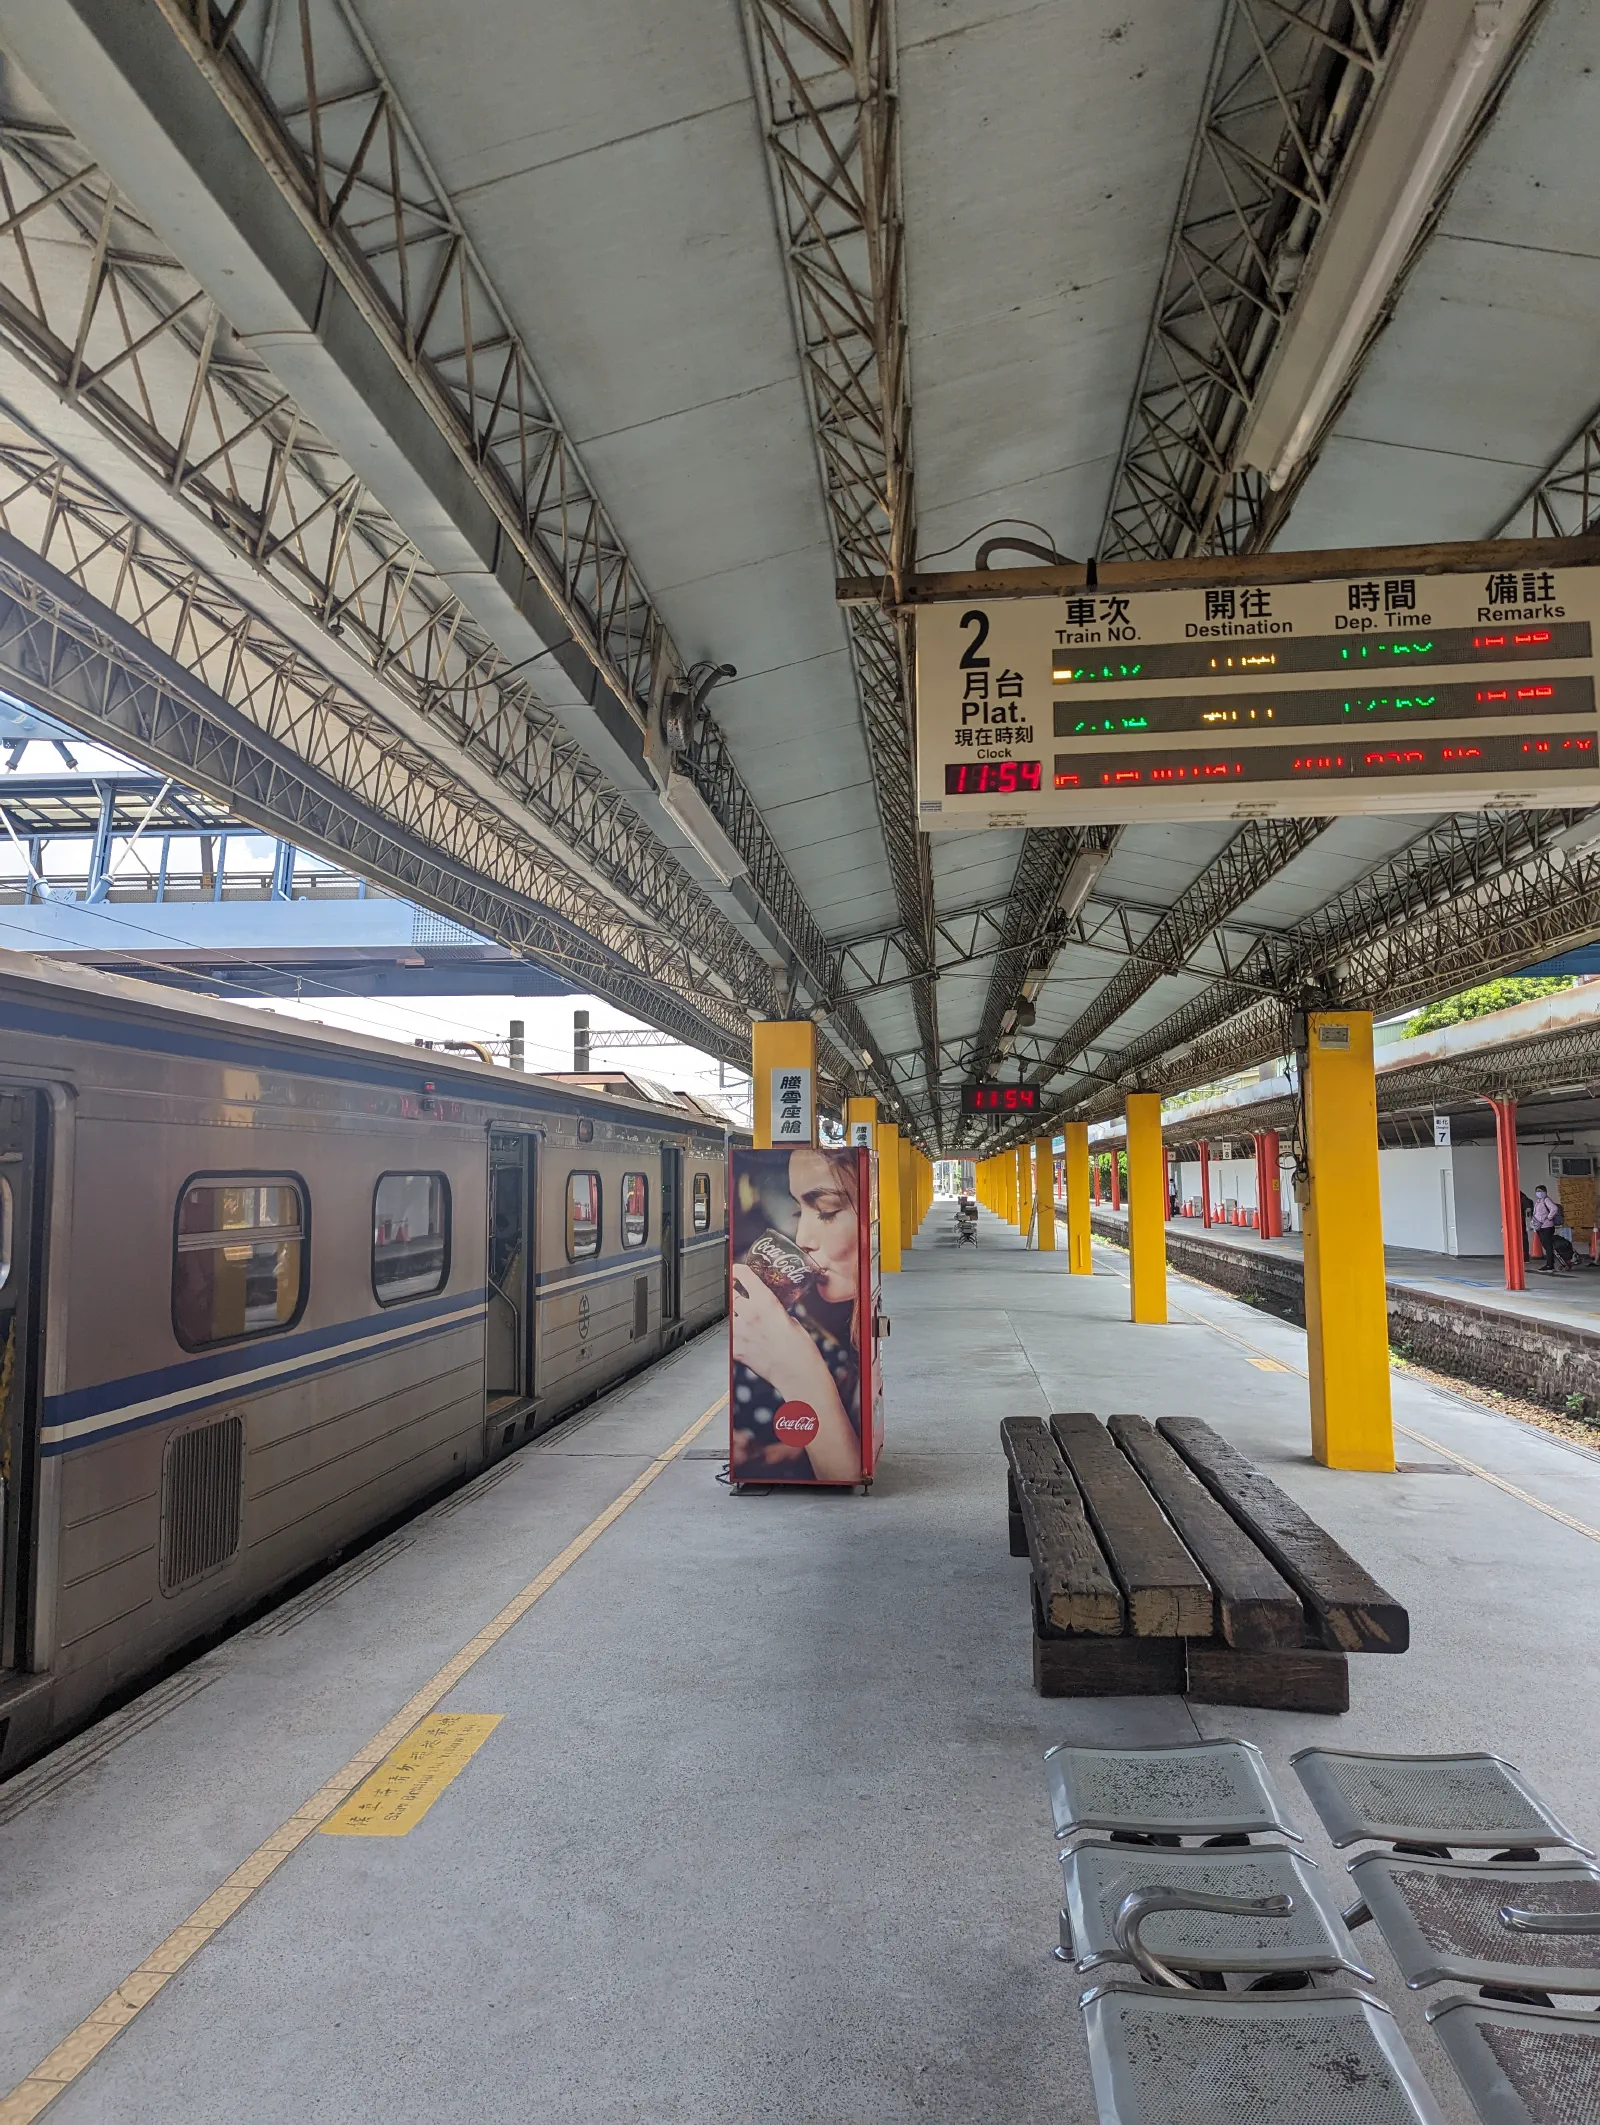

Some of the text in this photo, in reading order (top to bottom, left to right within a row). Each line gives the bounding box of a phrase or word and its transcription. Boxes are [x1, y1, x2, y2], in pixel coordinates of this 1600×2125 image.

[1348, 580, 1416, 612] 時間
[1485, 572, 1556, 605] 備註
[1065, 597, 1130, 628] 車次
[1205, 588, 1272, 621] 開往
[1477, 604, 1566, 622] Remarks
[1185, 620, 1293, 638] Destination
[1335, 611, 1432, 632] Dep. Time
[959, 610, 990, 669] 2
[1055, 626, 1141, 645] Train NO.
[963, 669, 1024, 700] 月台
[961, 701, 1026, 725] Plat.
[955, 725, 1033, 747] 現在時刻
[976, 748, 1012, 760] Clock
[956, 762, 1041, 793] 11:54
[780, 1075, 802, 1134] 騰雲座艙
[1438, 1133, 1446, 1143] 7
[775, 1416, 817, 1431] Coca-Cola
